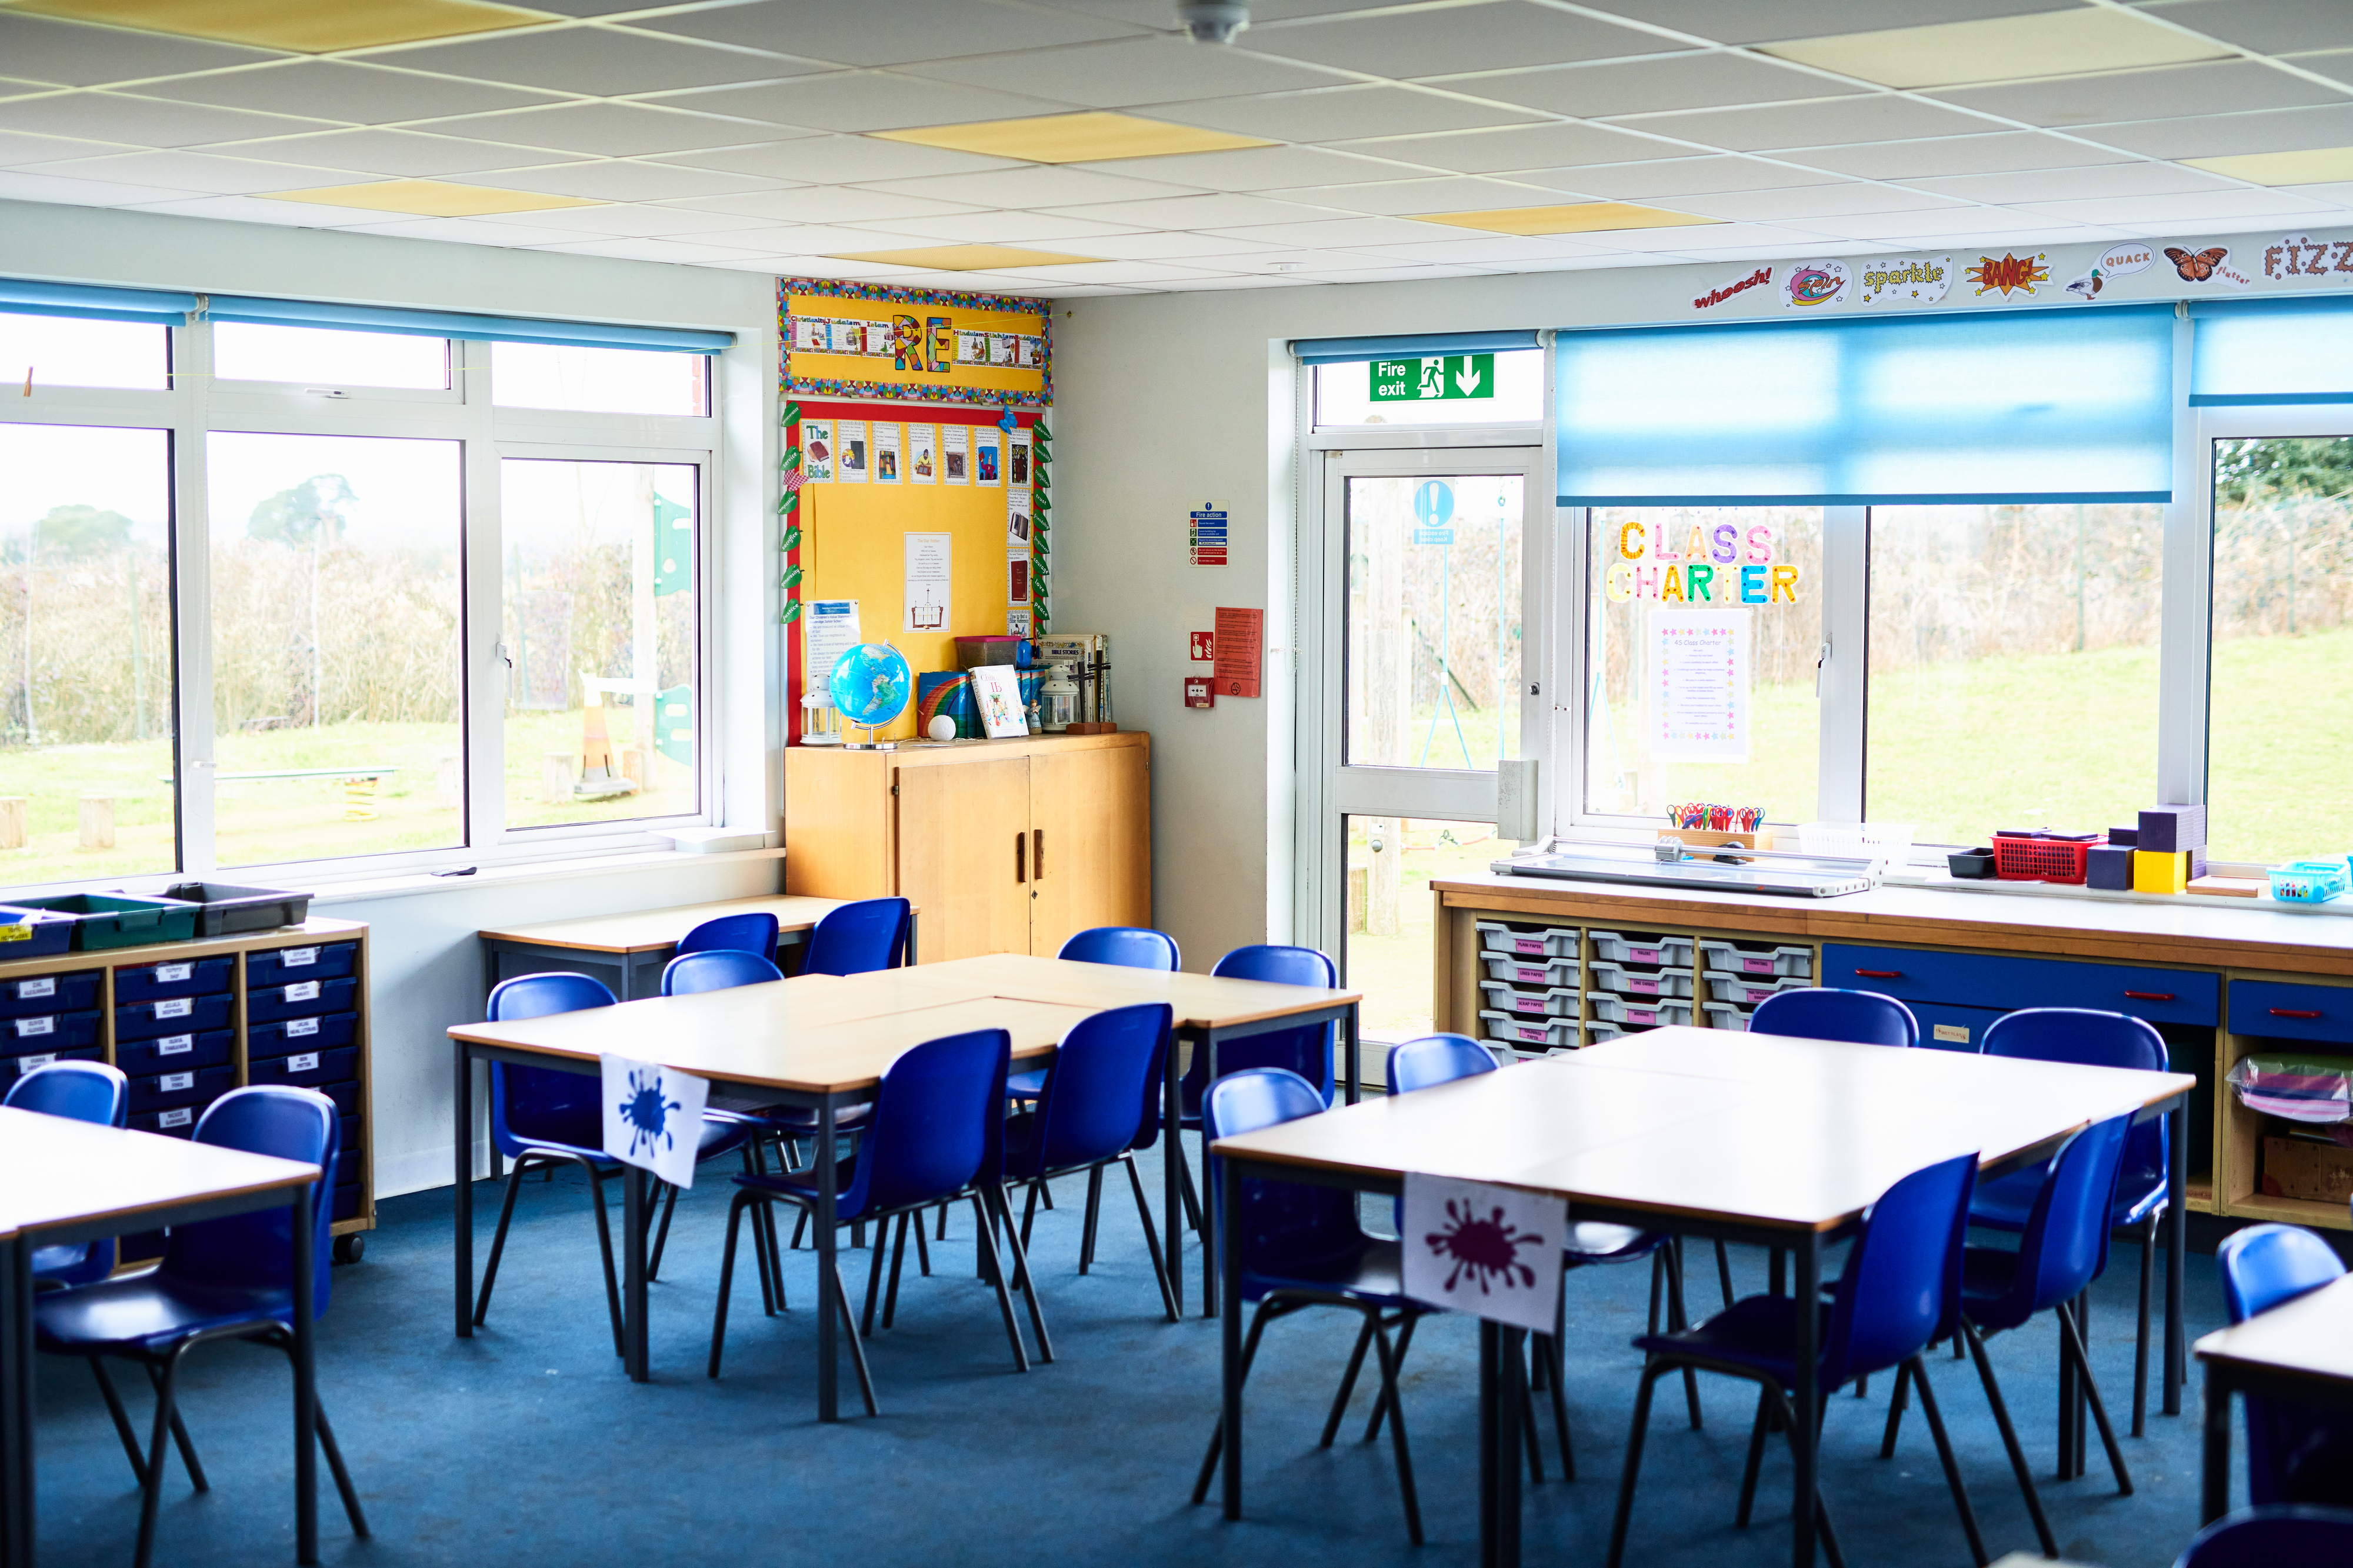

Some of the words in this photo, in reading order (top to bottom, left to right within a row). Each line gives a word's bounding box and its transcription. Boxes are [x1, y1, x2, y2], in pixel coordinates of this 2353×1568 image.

[2106, 252, 2151, 268] QUACK
[2265, 241, 2353, 276] FIZZ
[1864, 261, 1944, 294] sparkle
[1983, 257, 2034, 285] BANG!
[2216, 266, 2251, 286] flutter
[1694, 267, 1772, 309] whoosh!
[791, 316, 825, 325] Christianity
[892, 315, 951, 372] RE
[1378, 362, 1406, 376] Fire
[1378, 382, 1405, 396] exit
[782, 406, 799, 425] perseverance
[806, 425, 828, 439] The
[1034, 424, 1052, 439] endurance
[783, 452, 796, 468] service
[1035, 446, 1051, 462] responsibility
[808, 465, 830, 478] Bible
[1035, 469, 1050, 487] truthfulness
[778, 495, 796, 513] compassion
[1036, 493, 1046, 505] trust
[1033, 513, 1049, 529] friendship
[782, 531, 798, 550] sacrifice
[1034, 535, 1049, 553] forgiveness
[1620, 521, 1772, 565] CLASS
[1034, 557, 1048, 575] courage
[781, 568, 800, 588] generosity
[1035, 579, 1045, 593] love
[1607, 563, 1799, 604] CHARTER
[782, 603, 799, 622] justice
[1034, 602, 1048, 617] peace
[975, 688, 983, 712] Children's
